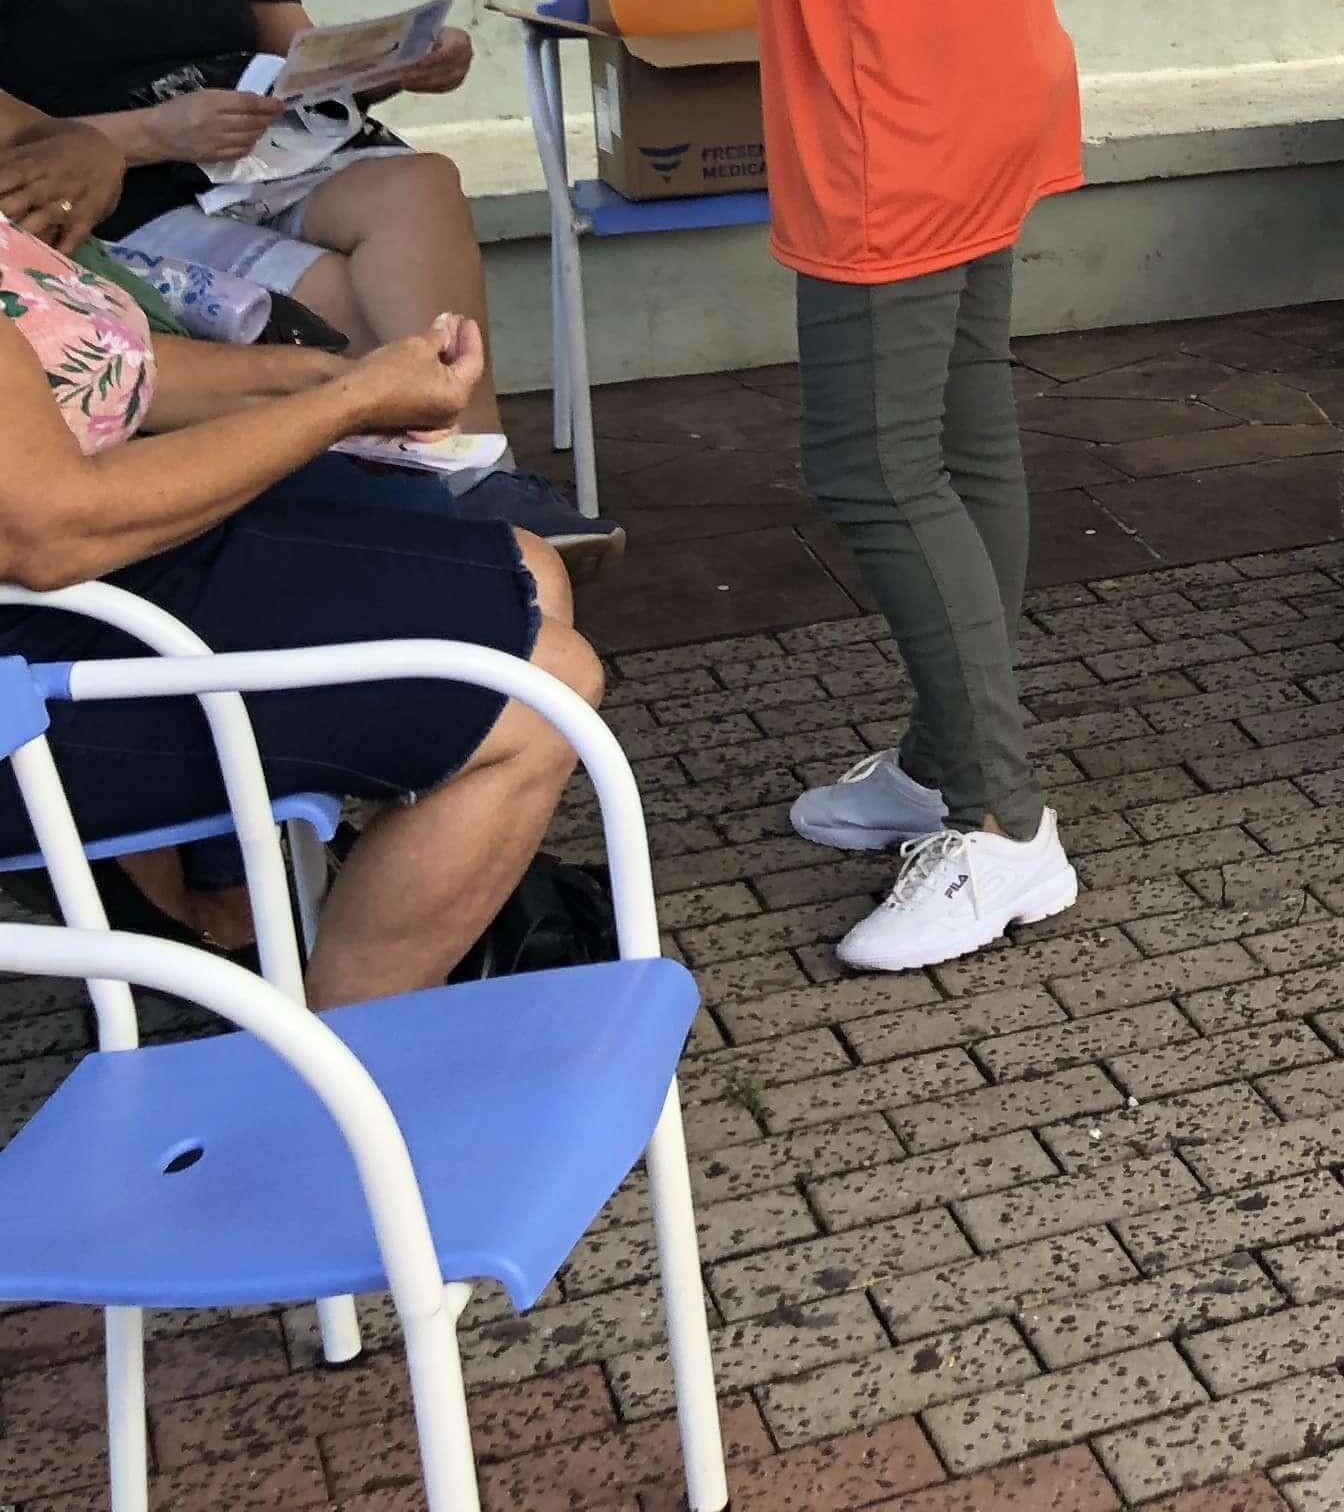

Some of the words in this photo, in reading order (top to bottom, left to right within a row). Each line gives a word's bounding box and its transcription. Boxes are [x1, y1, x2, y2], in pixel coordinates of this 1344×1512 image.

[703, 144, 767, 162] FRESEN
[703, 162, 767, 179] MEDICA
[944, 874, 969, 899] FILA
